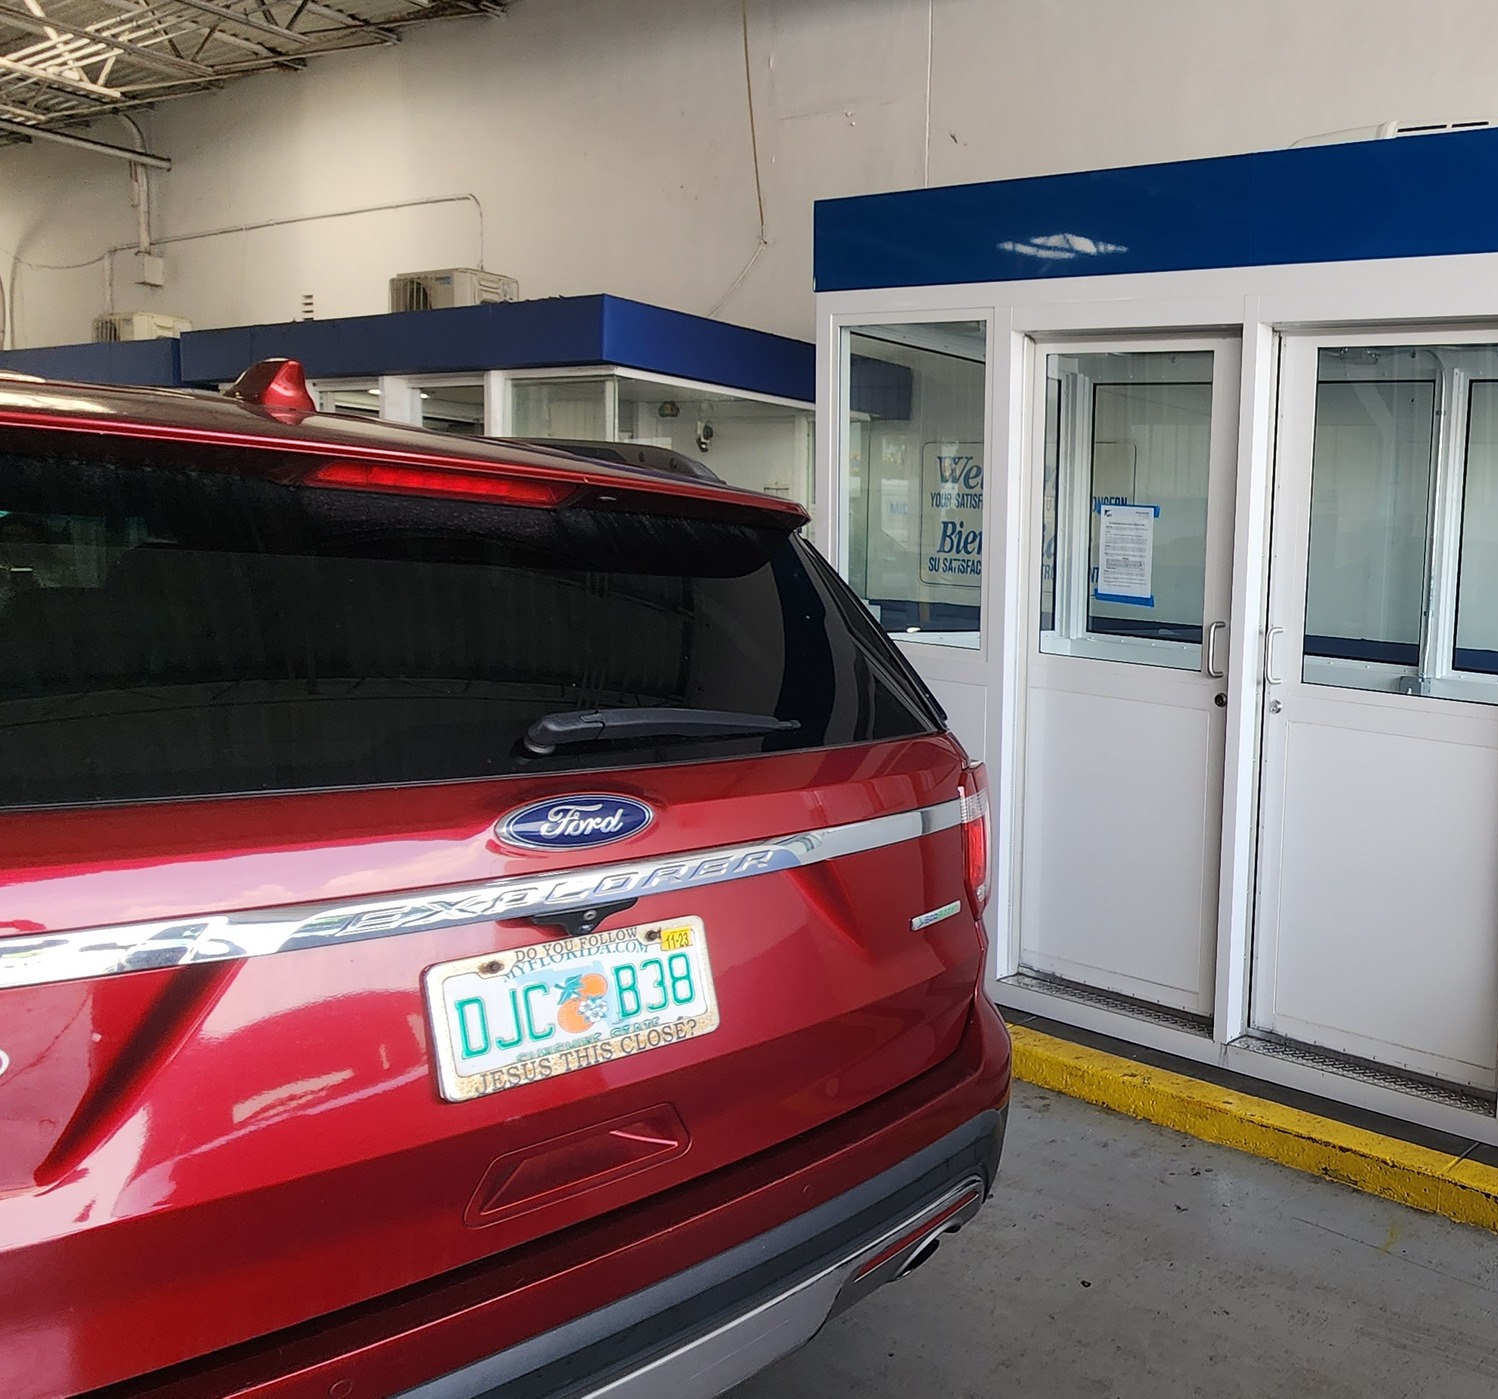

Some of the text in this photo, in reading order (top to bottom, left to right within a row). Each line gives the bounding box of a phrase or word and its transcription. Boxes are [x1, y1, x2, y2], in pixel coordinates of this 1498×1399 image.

[937, 456, 983, 489] We
[930, 492, 984, 509] YOUR SATISF
[928, 556, 982, 576] SU SATISFAC
[540, 803, 624, 838] Ford
[337, 849, 774, 936] EXPLORER
[515, 927, 638, 963] DO YOU FOLLOW
[665, 932, 690, 949] 11-23
[454, 952, 696, 1060] DJC B38
[475, 1018, 698, 1096] JESUS THIS CLOSE?
